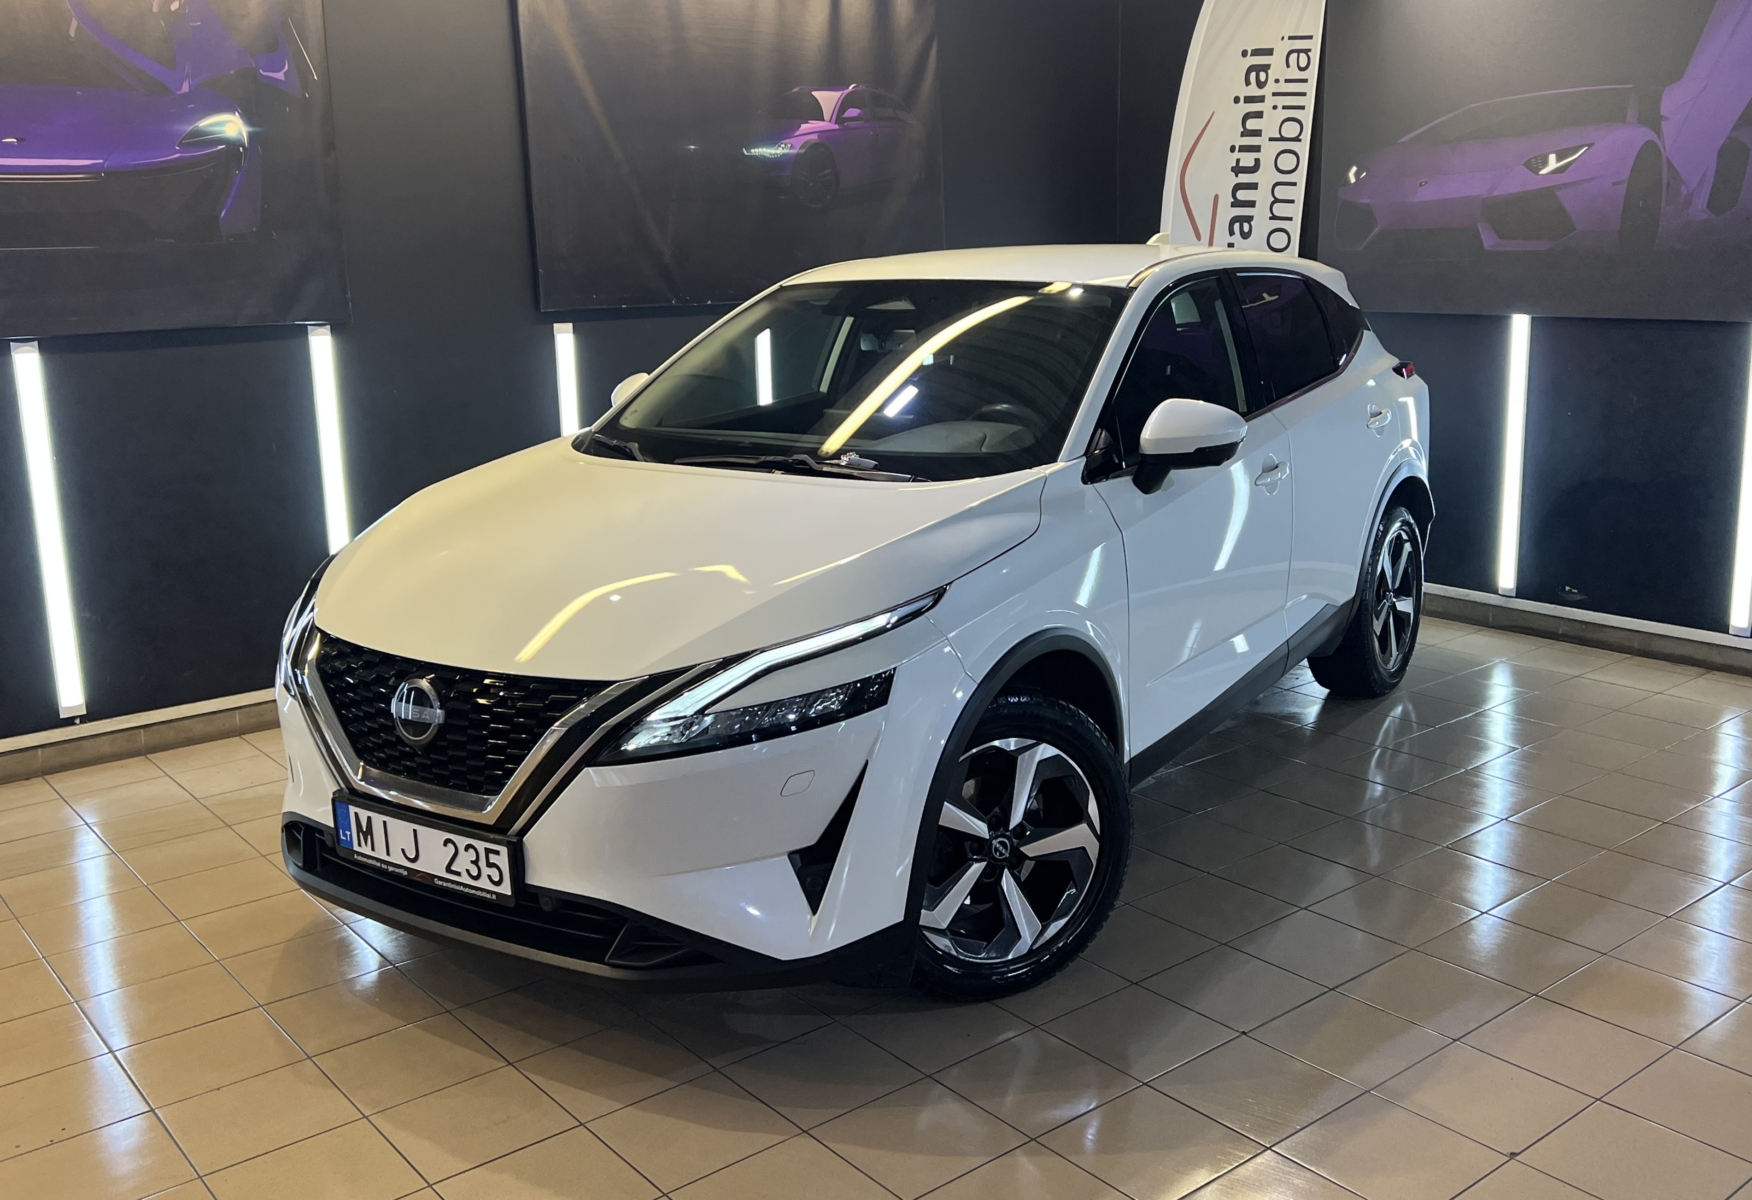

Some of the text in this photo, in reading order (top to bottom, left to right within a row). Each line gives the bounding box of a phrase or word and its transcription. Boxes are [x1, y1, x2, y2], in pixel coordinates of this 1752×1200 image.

[1227, 48, 1274, 248] antiniai
[1266, 34, 1314, 253] omobiliai
[340, 829, 351, 842] LT
[354, 811, 504, 887] MIJ 235
